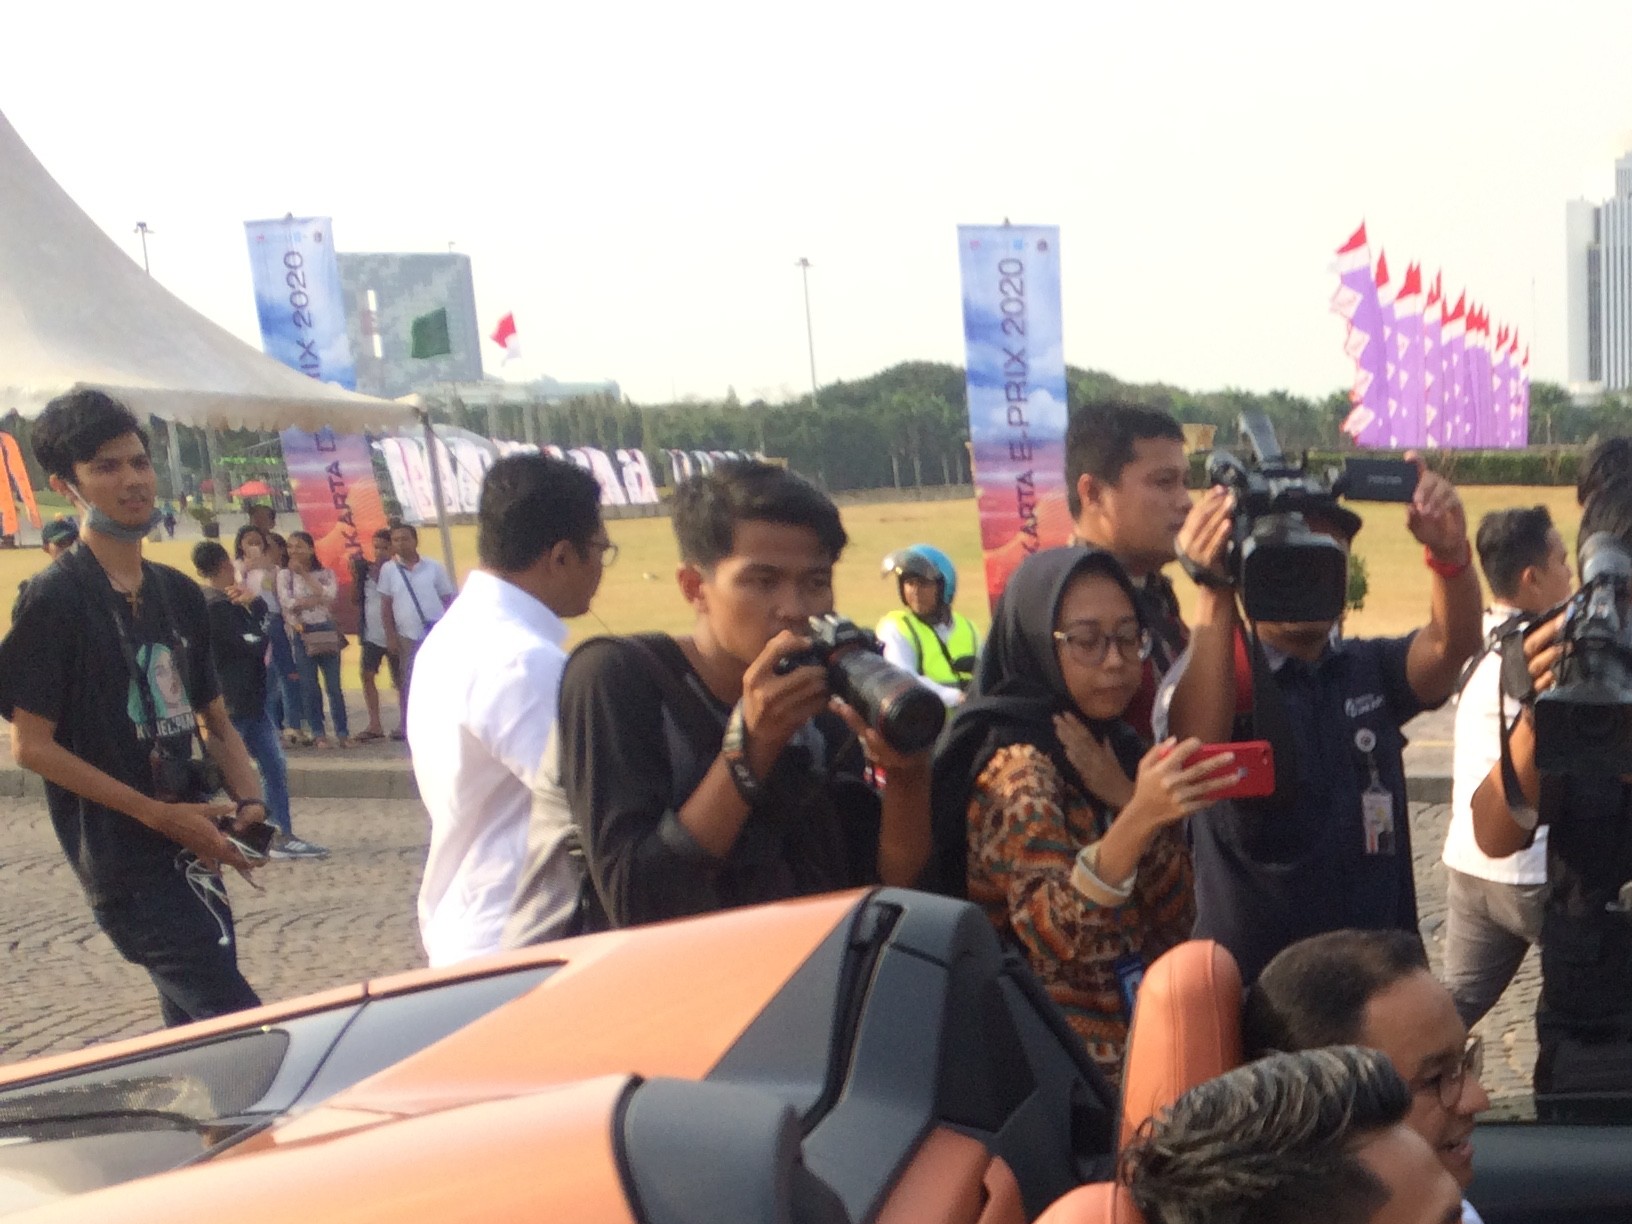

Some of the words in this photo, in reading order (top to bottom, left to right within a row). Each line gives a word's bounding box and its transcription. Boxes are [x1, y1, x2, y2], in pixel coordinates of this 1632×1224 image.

[283, 250, 313, 328] 2020
[998, 257, 1026, 337] 2020
[1002, 346, 1033, 462] E-PRIX
